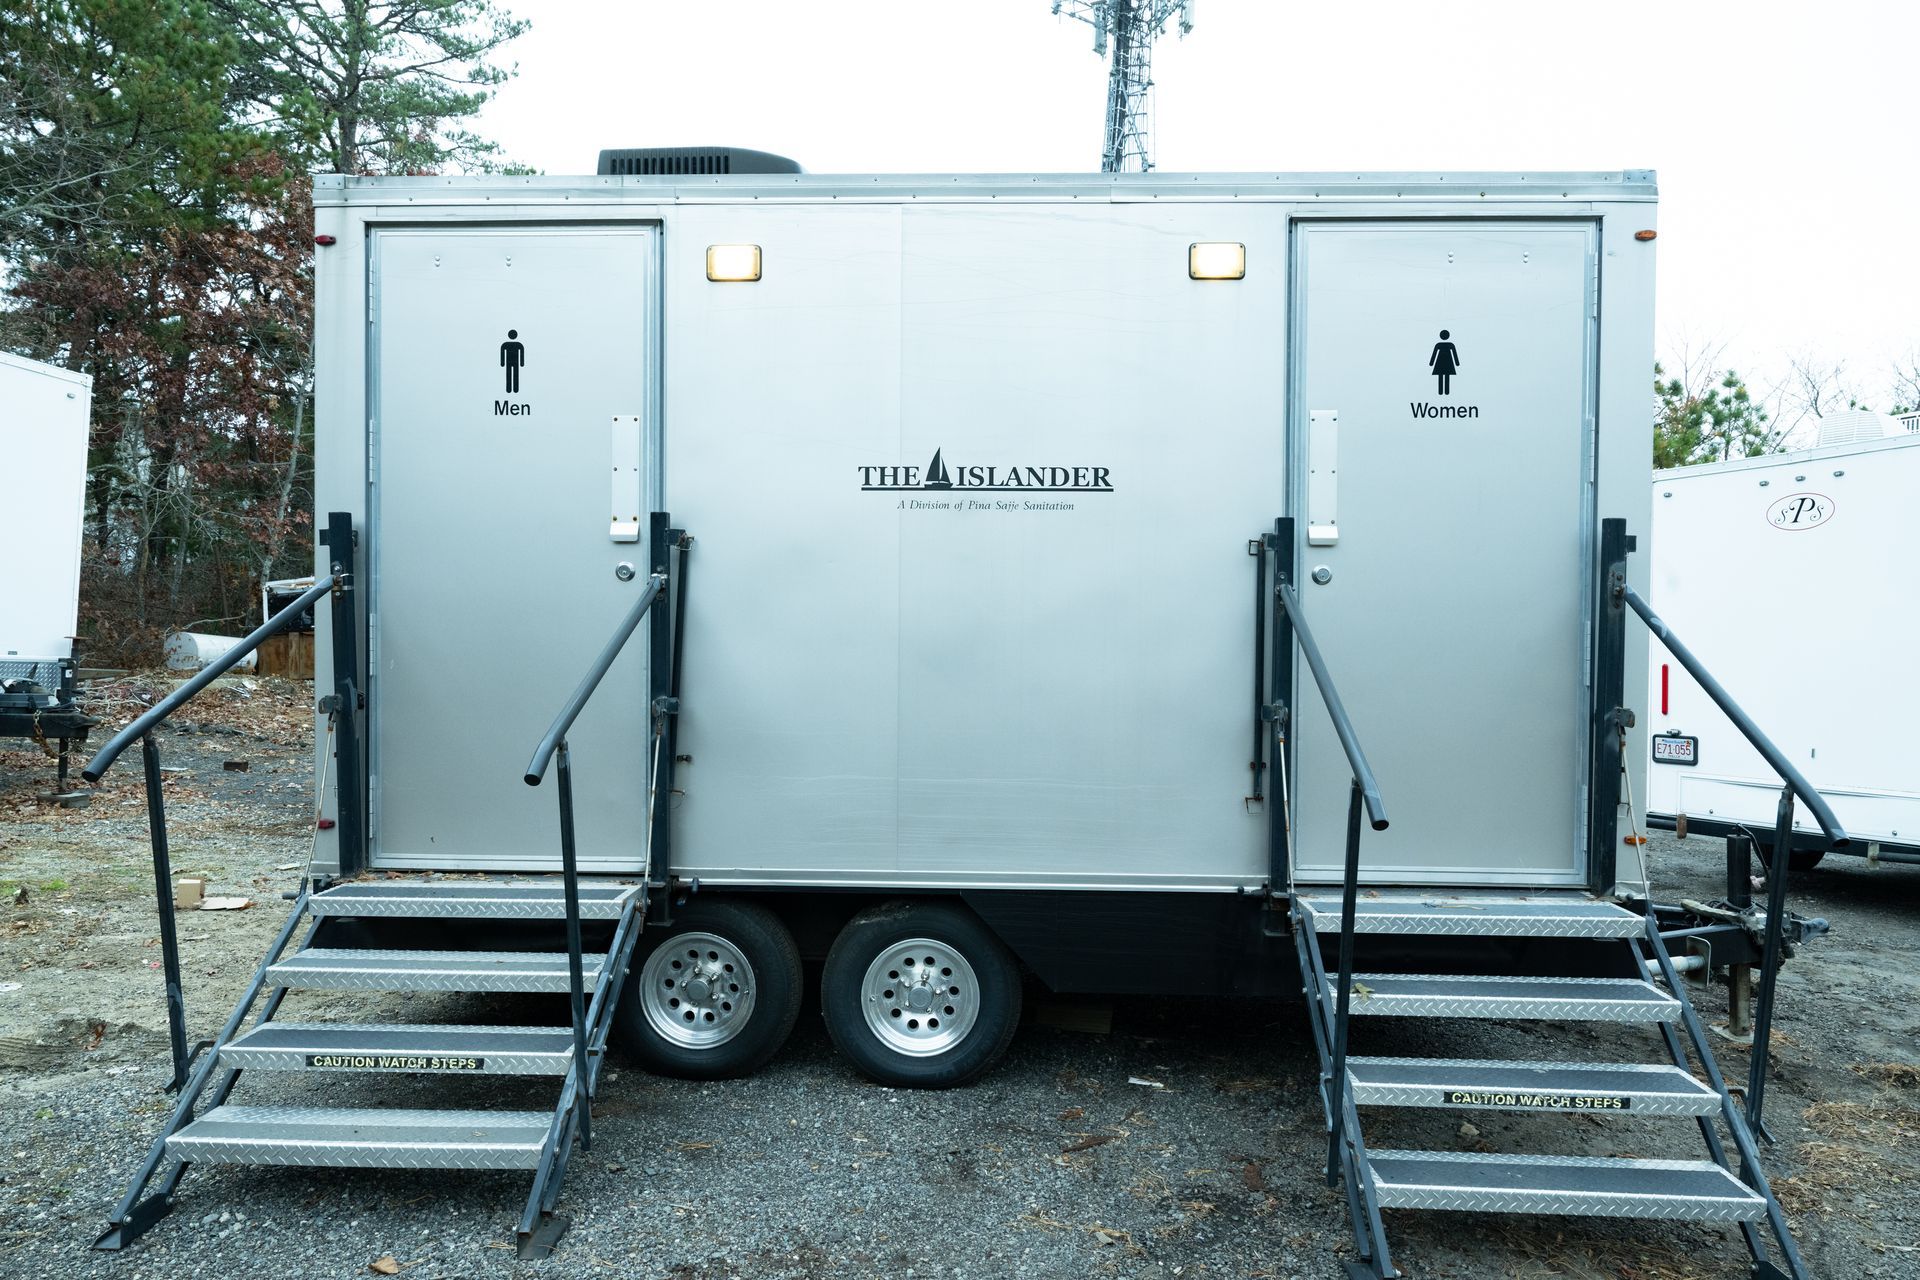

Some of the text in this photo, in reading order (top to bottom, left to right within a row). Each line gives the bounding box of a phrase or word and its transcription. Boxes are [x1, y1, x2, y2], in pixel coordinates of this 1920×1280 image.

[494, 400, 531, 416] Men
[1410, 402, 1479, 418] Women
[857, 465, 1114, 488] THE ISLANDER
[896, 499, 906, 511] A
[910, 499, 950, 511] Division
[954, 500, 964, 512] of
[968, 500, 991, 511] Pina
[1023, 500, 1075, 512] Sanitation
[313, 1055, 477, 1070] CAUTION WATCH STEPS
[1451, 1092, 1623, 1109] CAUTION WATCH STEPS
